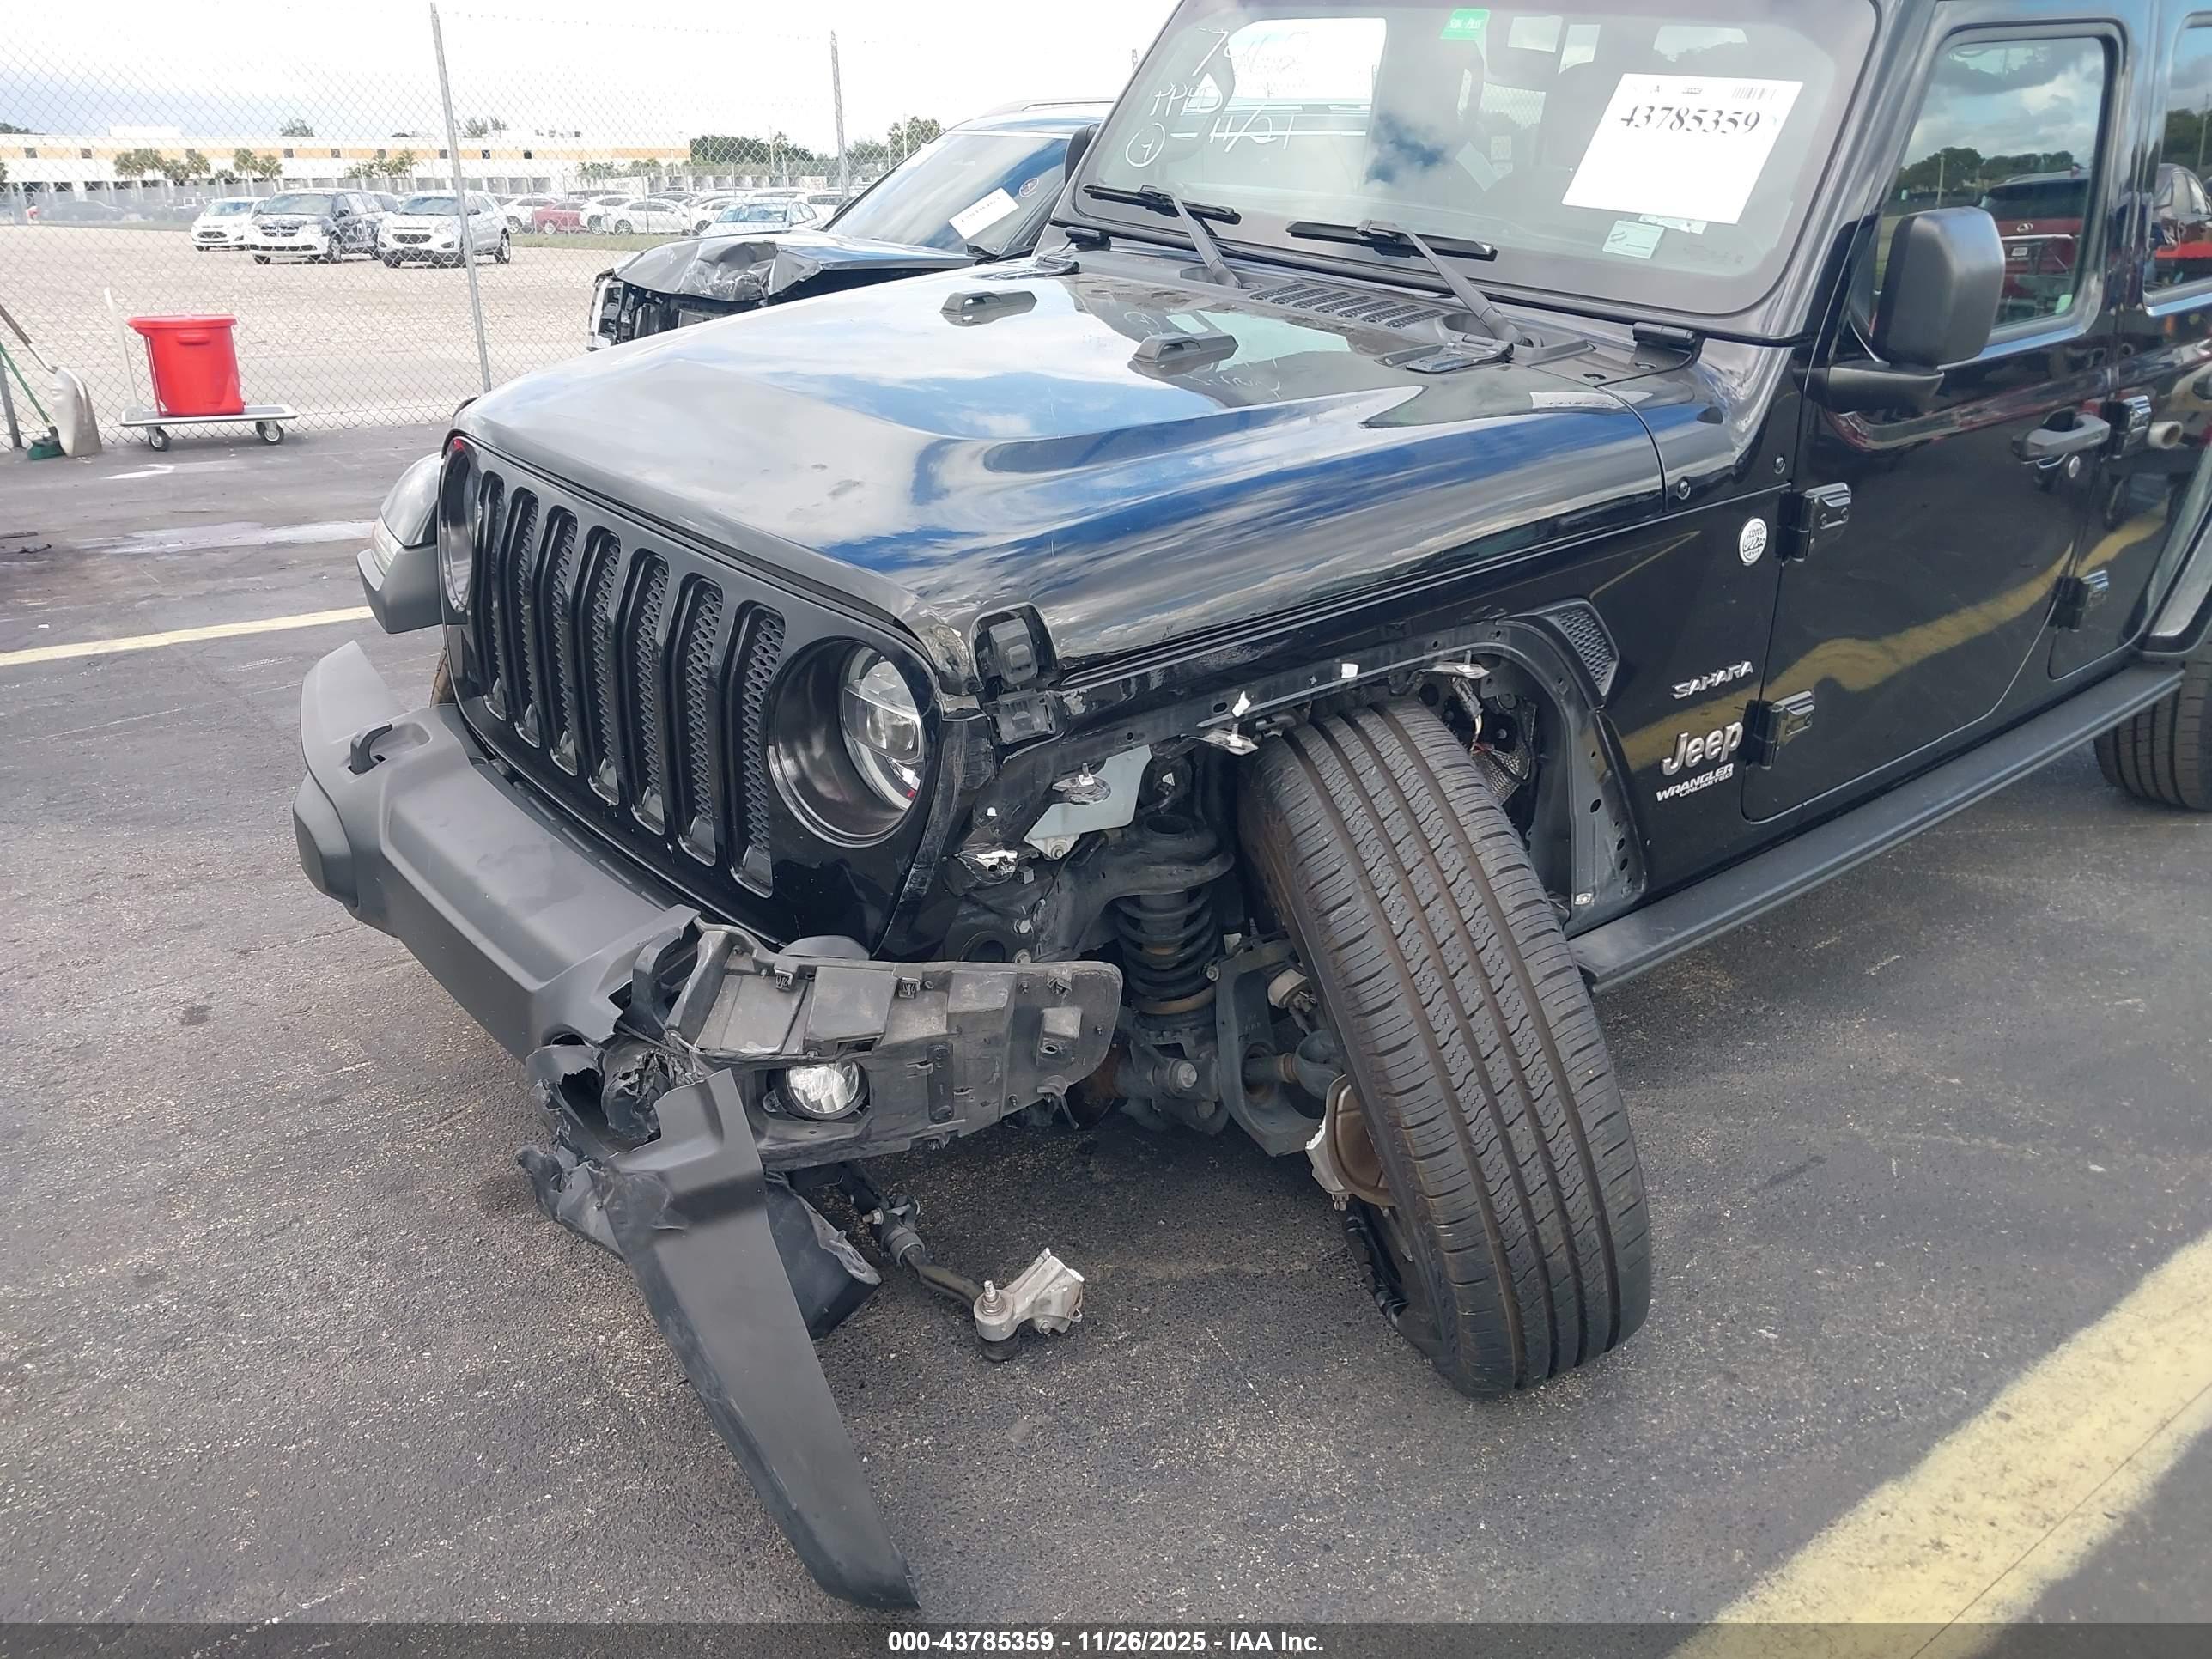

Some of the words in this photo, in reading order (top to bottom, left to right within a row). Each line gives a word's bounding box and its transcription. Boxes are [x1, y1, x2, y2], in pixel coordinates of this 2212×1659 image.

[1620, 105, 1760, 134] 43785359
[1671, 660, 1753, 700] SAHARA
[1661, 721, 1743, 776] Jeep
[1656, 763, 1735, 802] WRANGLER
[1679, 772, 1734, 798] UNLIMITED
